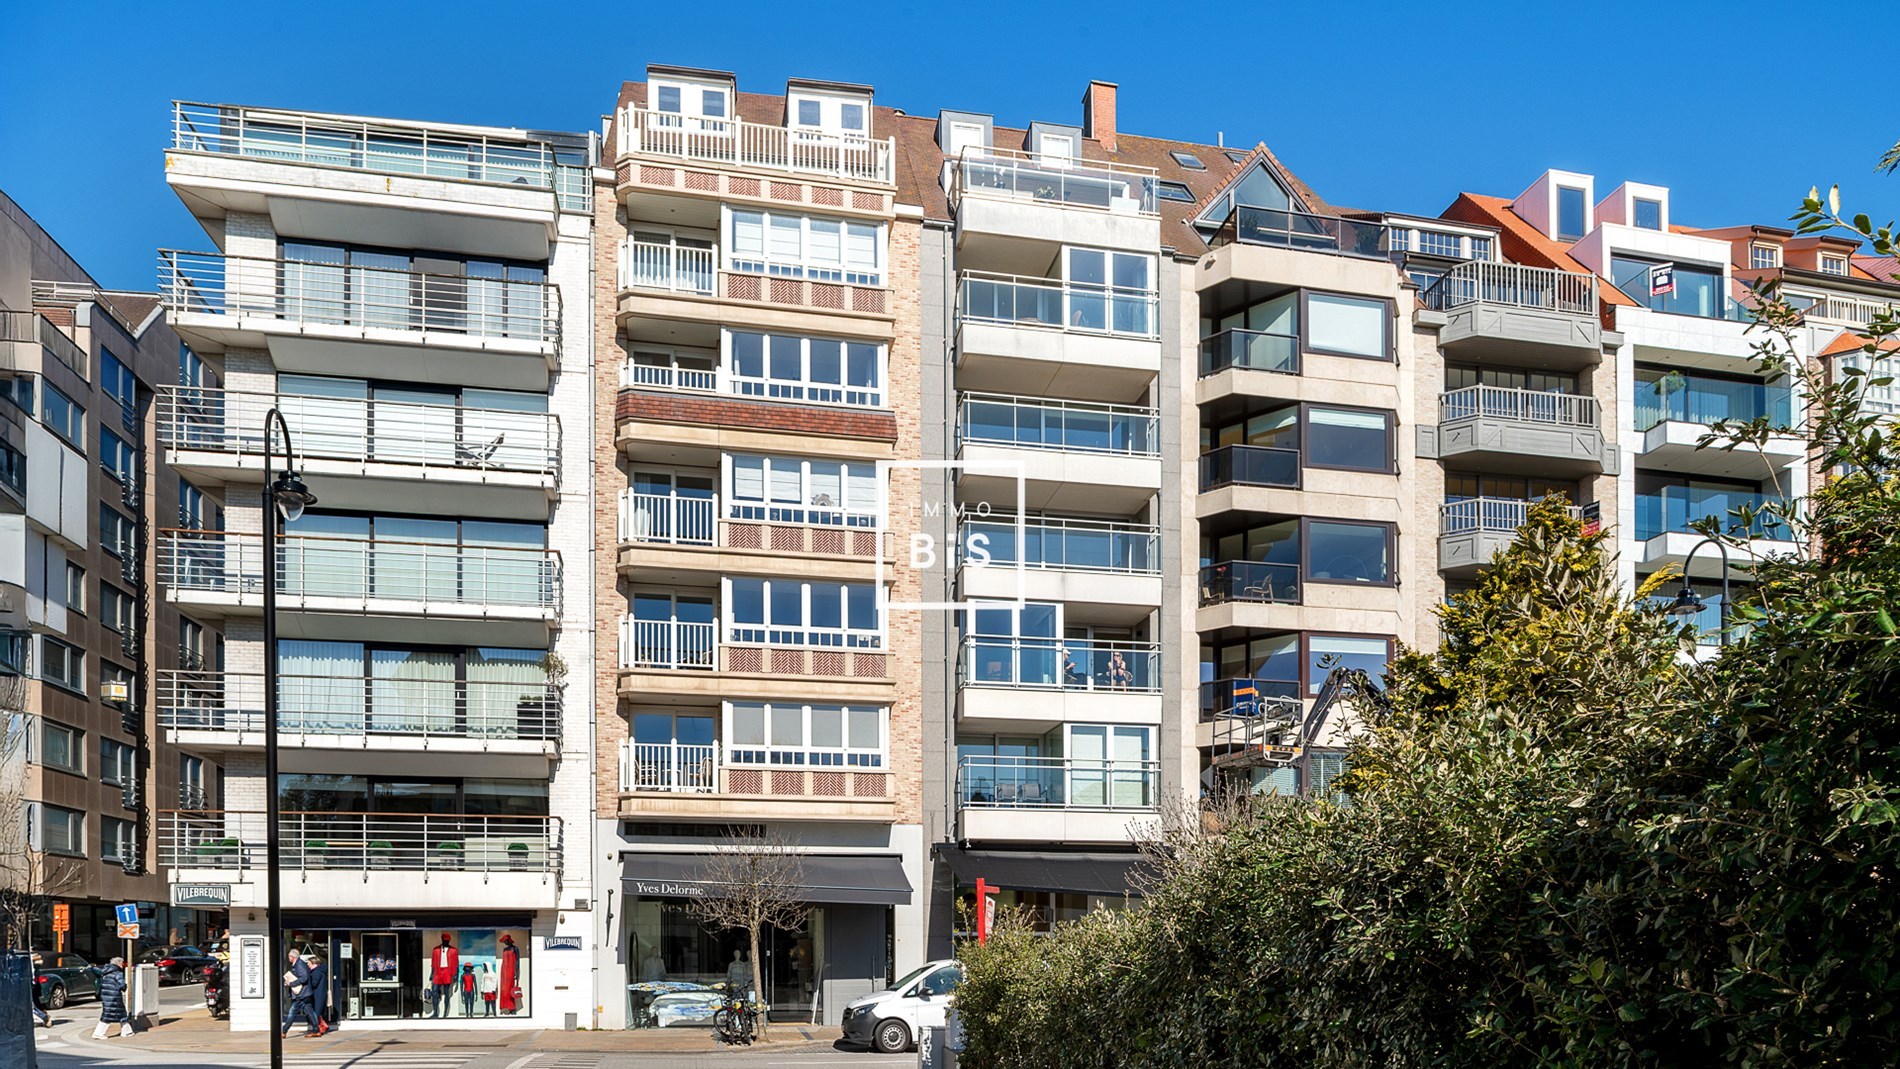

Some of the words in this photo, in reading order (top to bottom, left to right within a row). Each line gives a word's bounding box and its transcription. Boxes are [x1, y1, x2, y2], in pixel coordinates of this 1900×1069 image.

[177, 887, 227, 902] VILEBREQUIN
[636, 882, 659, 894] Yves
[661, 883, 704, 895] Delorme
[545, 937, 580, 949] VILEBREQUIN
